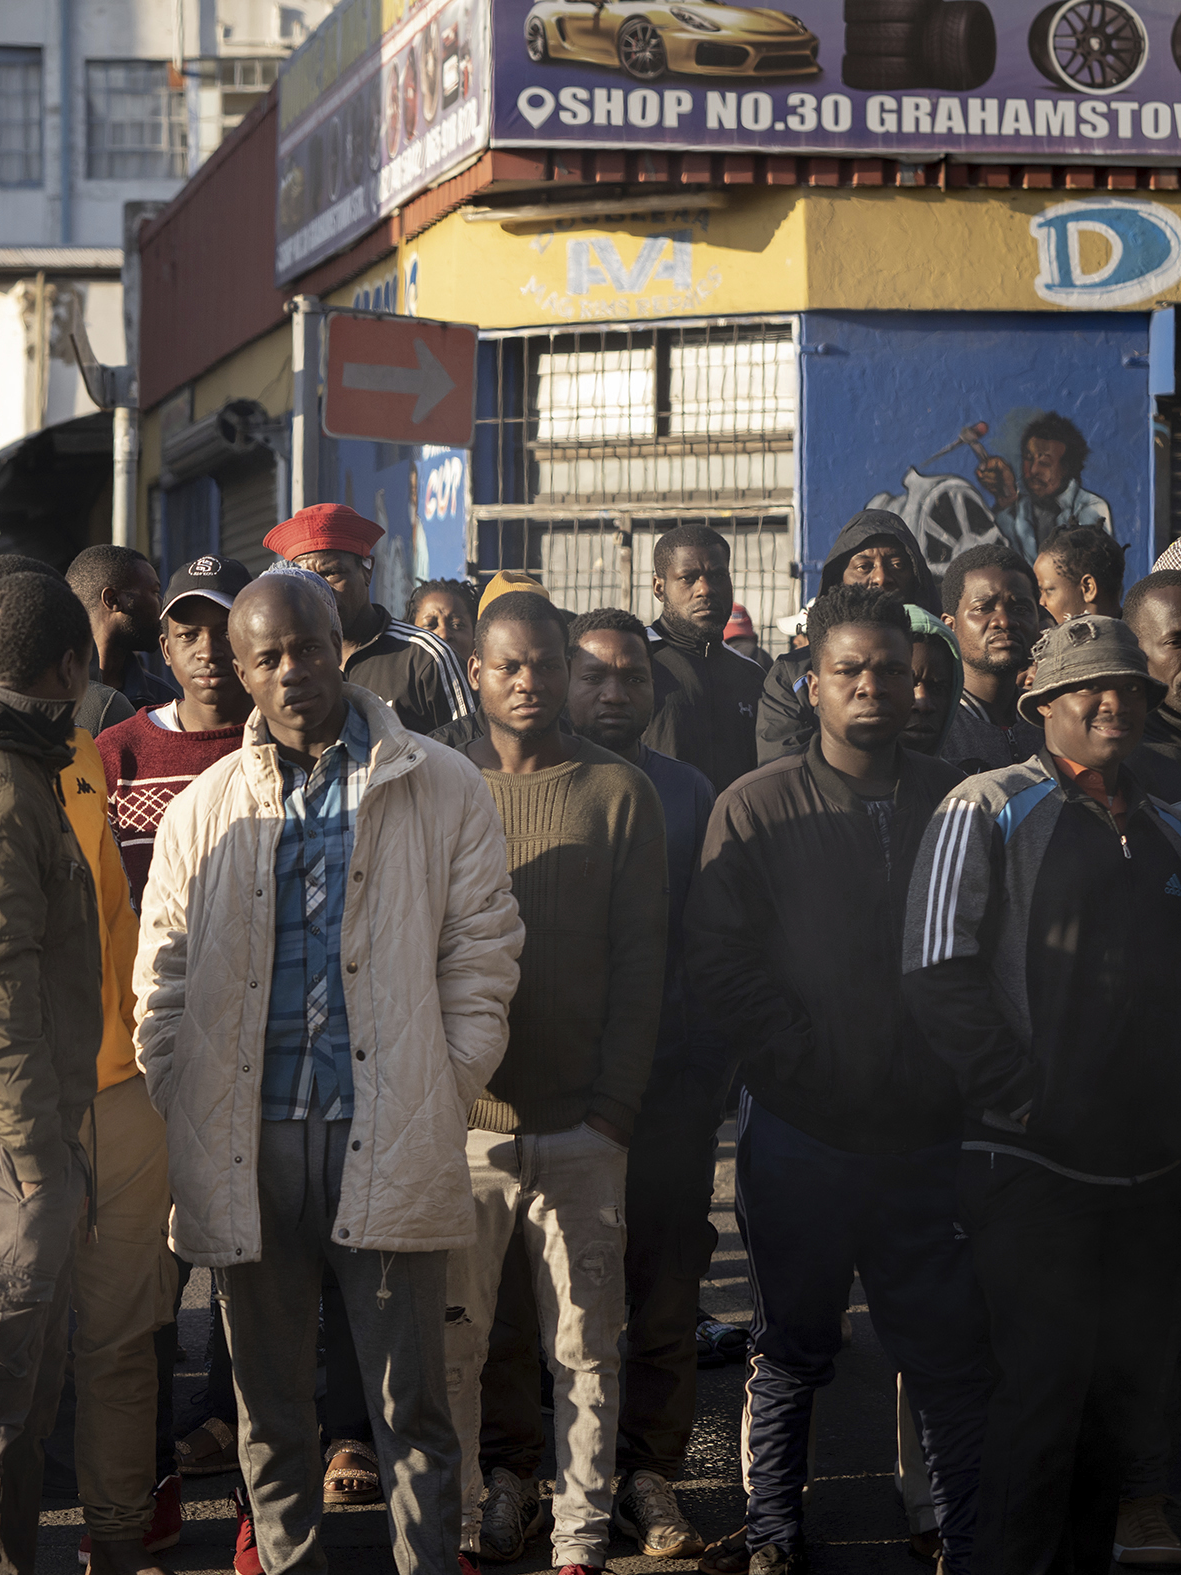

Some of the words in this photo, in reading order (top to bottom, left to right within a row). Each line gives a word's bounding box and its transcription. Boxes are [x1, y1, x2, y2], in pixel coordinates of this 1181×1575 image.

[559, 86, 693, 128] SHOP
[706, 90, 852, 133] NO.30
[866, 94, 1181, 139] GRAHAMSTO
